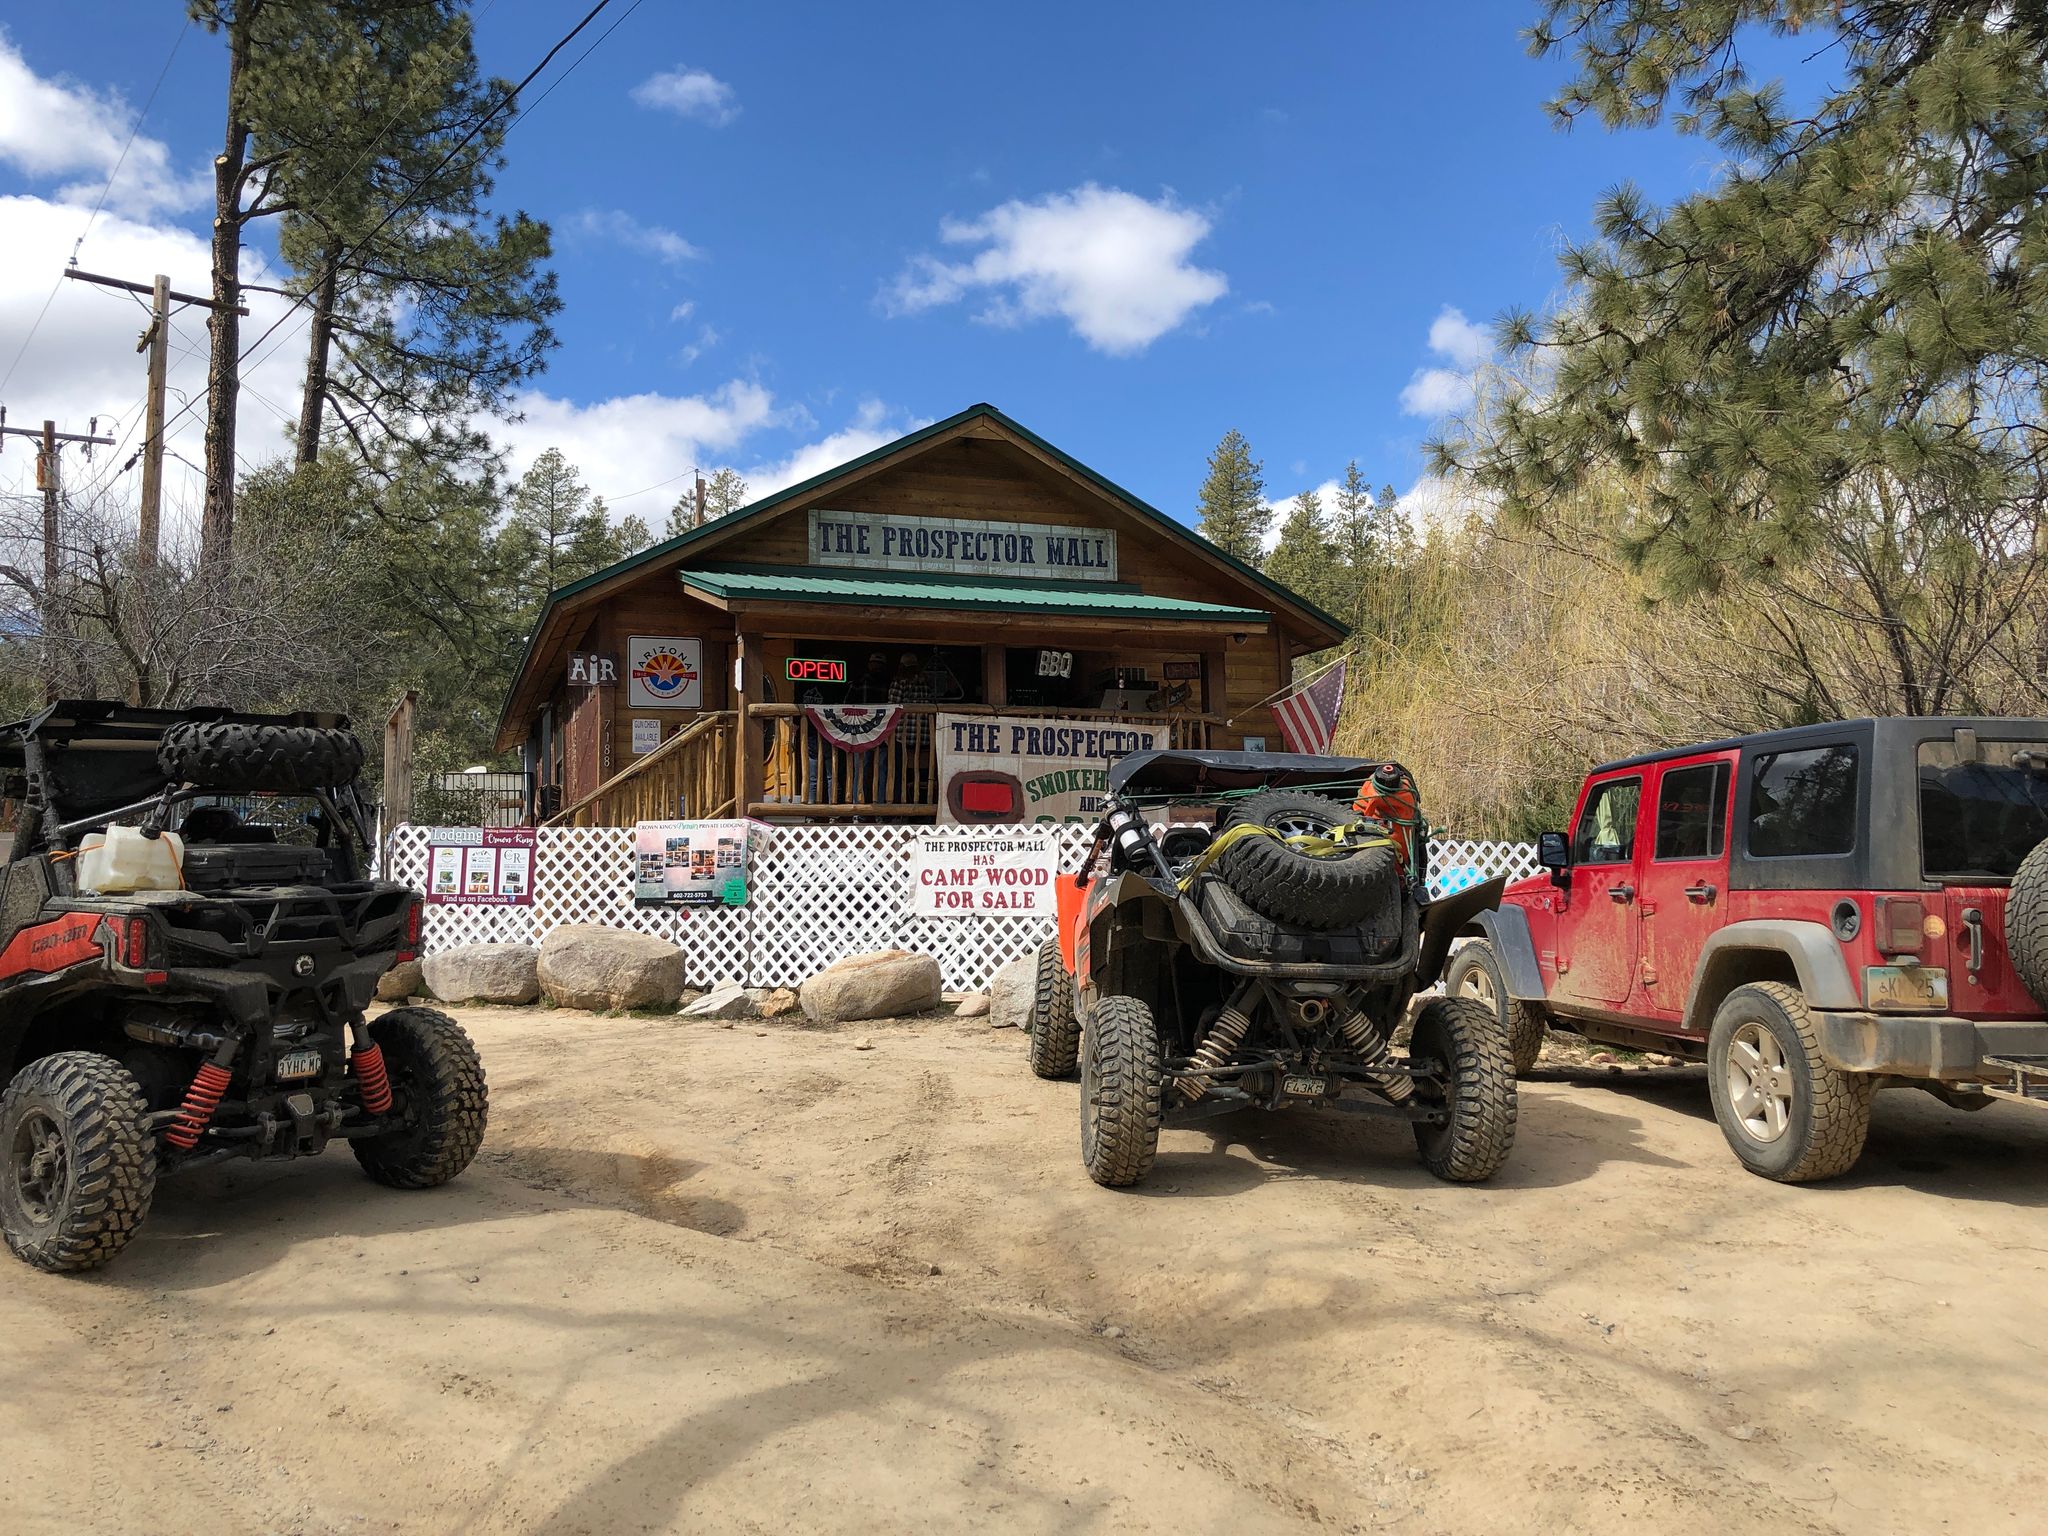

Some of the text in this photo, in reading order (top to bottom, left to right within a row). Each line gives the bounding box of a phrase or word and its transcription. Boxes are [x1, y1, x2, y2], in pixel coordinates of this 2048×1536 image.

[818, 522, 1108, 568] THE PROSPECTOR MALL
[638, 646, 692, 670] ARIZONA
[1038, 650, 1072, 679] BBQ
[789, 660, 843, 680] OPEN
[644, 721, 659, 729] CHECK
[951, 722, 1154, 759] THE PROSPECTOR
[1025, 769, 1107, 803] SMOKEH
[432, 829, 483, 844] Lodging
[485, 833, 534, 847] Crown King
[925, 840, 1046, 852] THE PROSPECTOR MALL
[973, 854, 995, 866] HAS
[920, 868, 1049, 886] CAMP WOOD
[477, 895, 509, 903] Facebook
[934, 891, 1036, 909] FOR SALE
